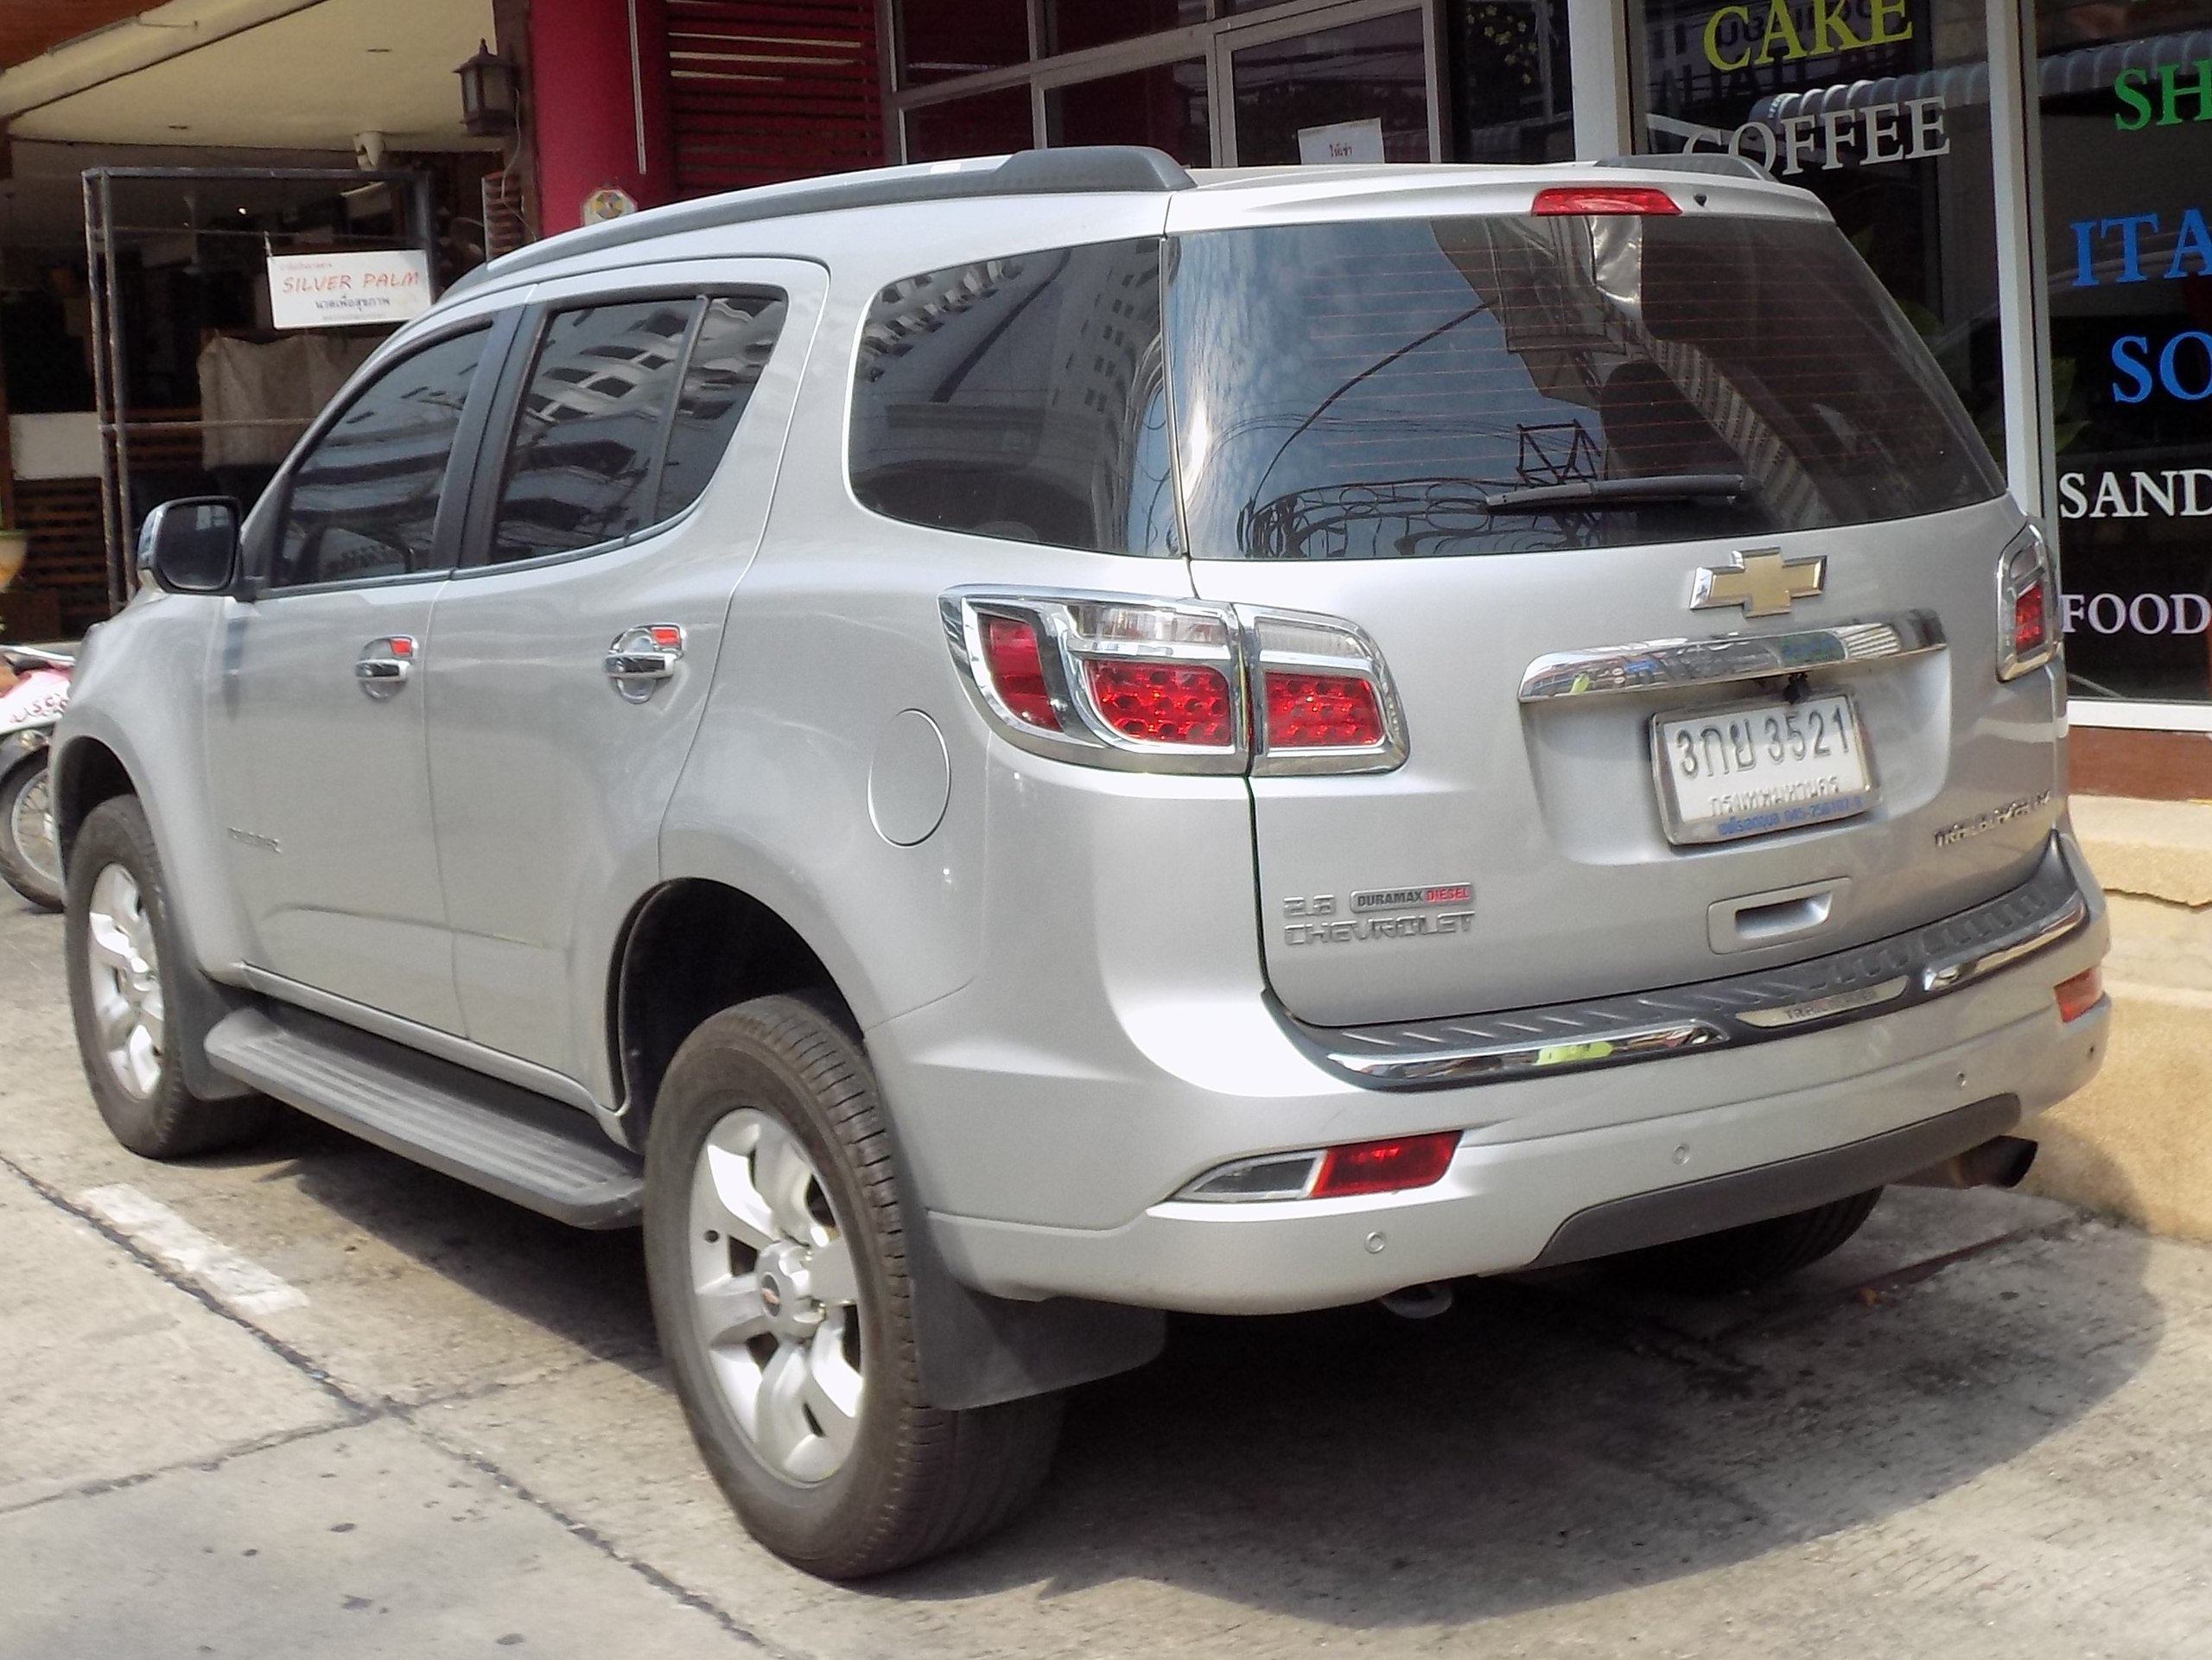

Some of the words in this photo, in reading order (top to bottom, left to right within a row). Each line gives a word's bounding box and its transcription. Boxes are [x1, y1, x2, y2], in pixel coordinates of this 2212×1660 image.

[1703, 0, 1914, 72] CAKE
[282, 274, 353, 293] SILVER
[363, 271, 420, 289] PALM
[2062, 593, 2211, 634] FOOD
[1764, 704, 1850, 764] 3521
[1709, 775, 1840, 817] กรงเทพมหานคร
[1357, 890, 1423, 906] DURAMAX
[1426, 887, 1470, 901] DIESEL
[1284, 911, 1476, 945] CHEVROLET
